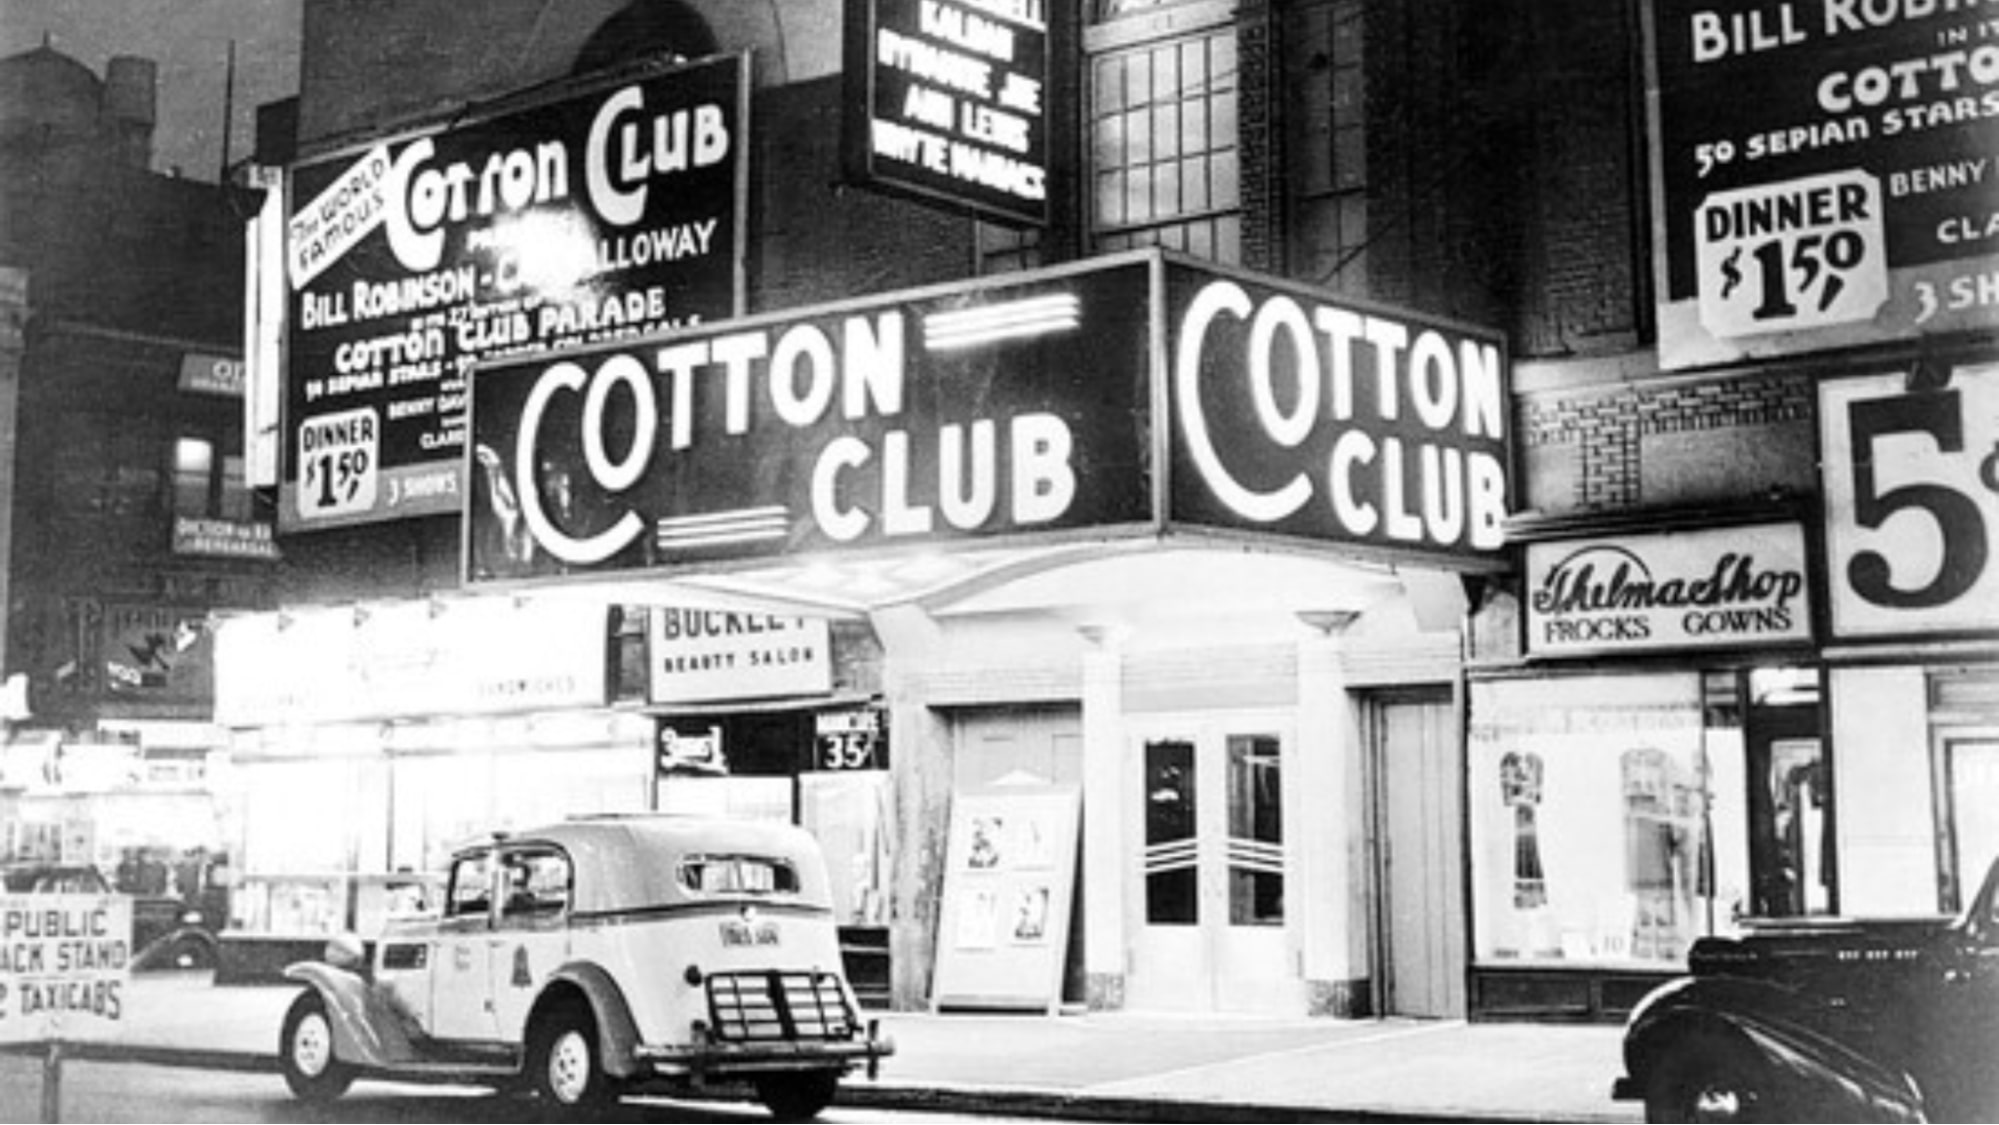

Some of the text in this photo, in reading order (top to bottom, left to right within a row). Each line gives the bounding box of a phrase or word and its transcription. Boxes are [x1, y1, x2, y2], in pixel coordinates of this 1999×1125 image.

[1690, 4, 1807, 63] BILL
[1937, 26, 1968, 47] IN
[1817, 46, 1999, 113] COTTO
[586, 85, 730, 226] CLUB
[1695, 88, 1999, 178] 50 SEPIAN STARS
[320, 158, 385, 223] WORLD
[1889, 158, 1987, 197] BENNY
[299, 187, 385, 271] FAMOUS
[1705, 183, 1870, 243] DINNER
[302, 292, 348, 330] BILL
[353, 265, 475, 322] ROBINSON
[1913, 281, 1939, 326] 3
[335, 328, 445, 374] COTTON
[457, 312, 530, 352] CLUB
[538, 286, 666, 338] PARADE
[1177, 279, 1503, 523] COTTON
[303, 417, 374, 452] DINNER
[516, 310, 903, 565] COTTON
[811, 412, 1077, 542] CLUB
[1329, 428, 1508, 551] CLUB
[1687, 552, 1803, 608] Shop
[1543, 606, 1794, 644] FROCKS GOWNS
[664, 647, 814, 674] BEAUTY SALON
[5, 909, 107, 938] PUBLIC
[0, 939, 127, 974] ACK STAND
[18, 979, 121, 1021] TAXICABS
